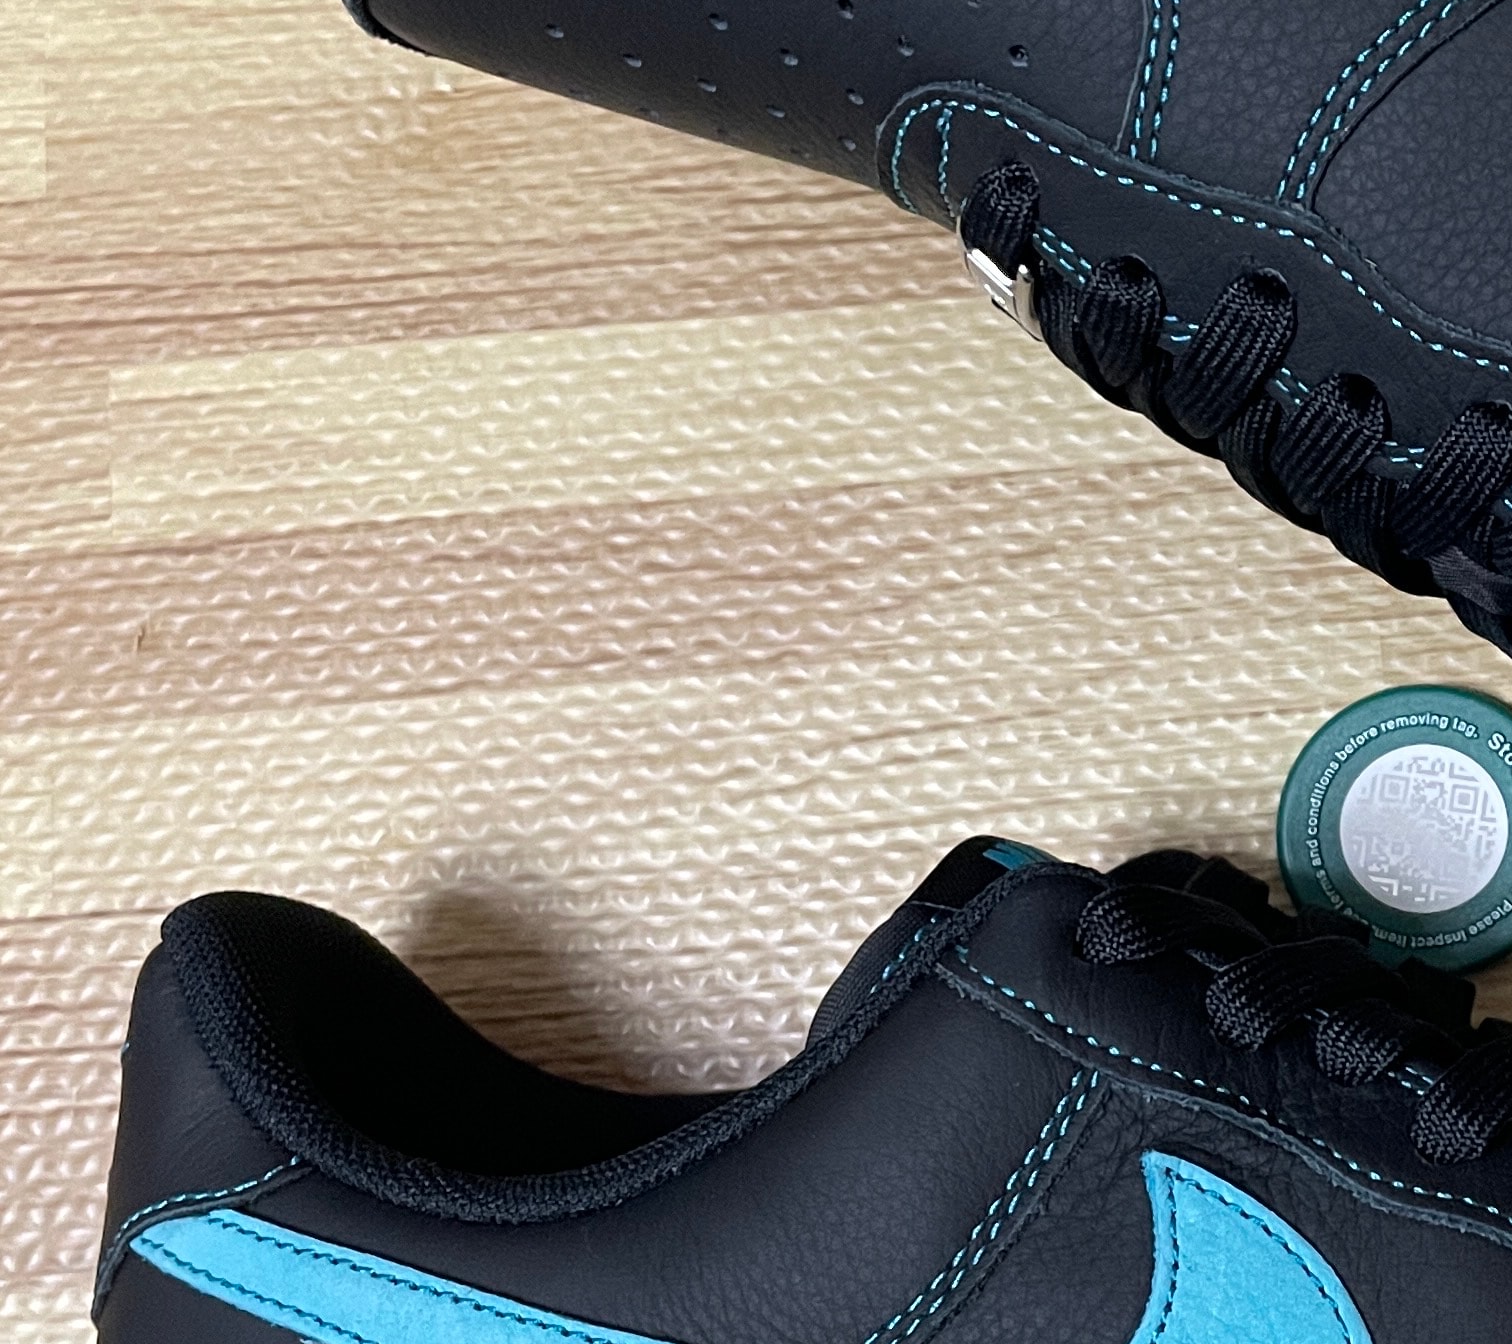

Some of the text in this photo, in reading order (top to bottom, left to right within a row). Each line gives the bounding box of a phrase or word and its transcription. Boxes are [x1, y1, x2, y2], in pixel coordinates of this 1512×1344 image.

[1381, 712, 1449, 733] removing
[1453, 717, 1479, 739] tag.
[1335, 726, 1379, 762] before
[1307, 761, 1340, 835] conditions
[1305, 839, 1322, 867] and
[1468, 899, 1512, 935] Please
[1411, 929, 1467, 948] inspect
